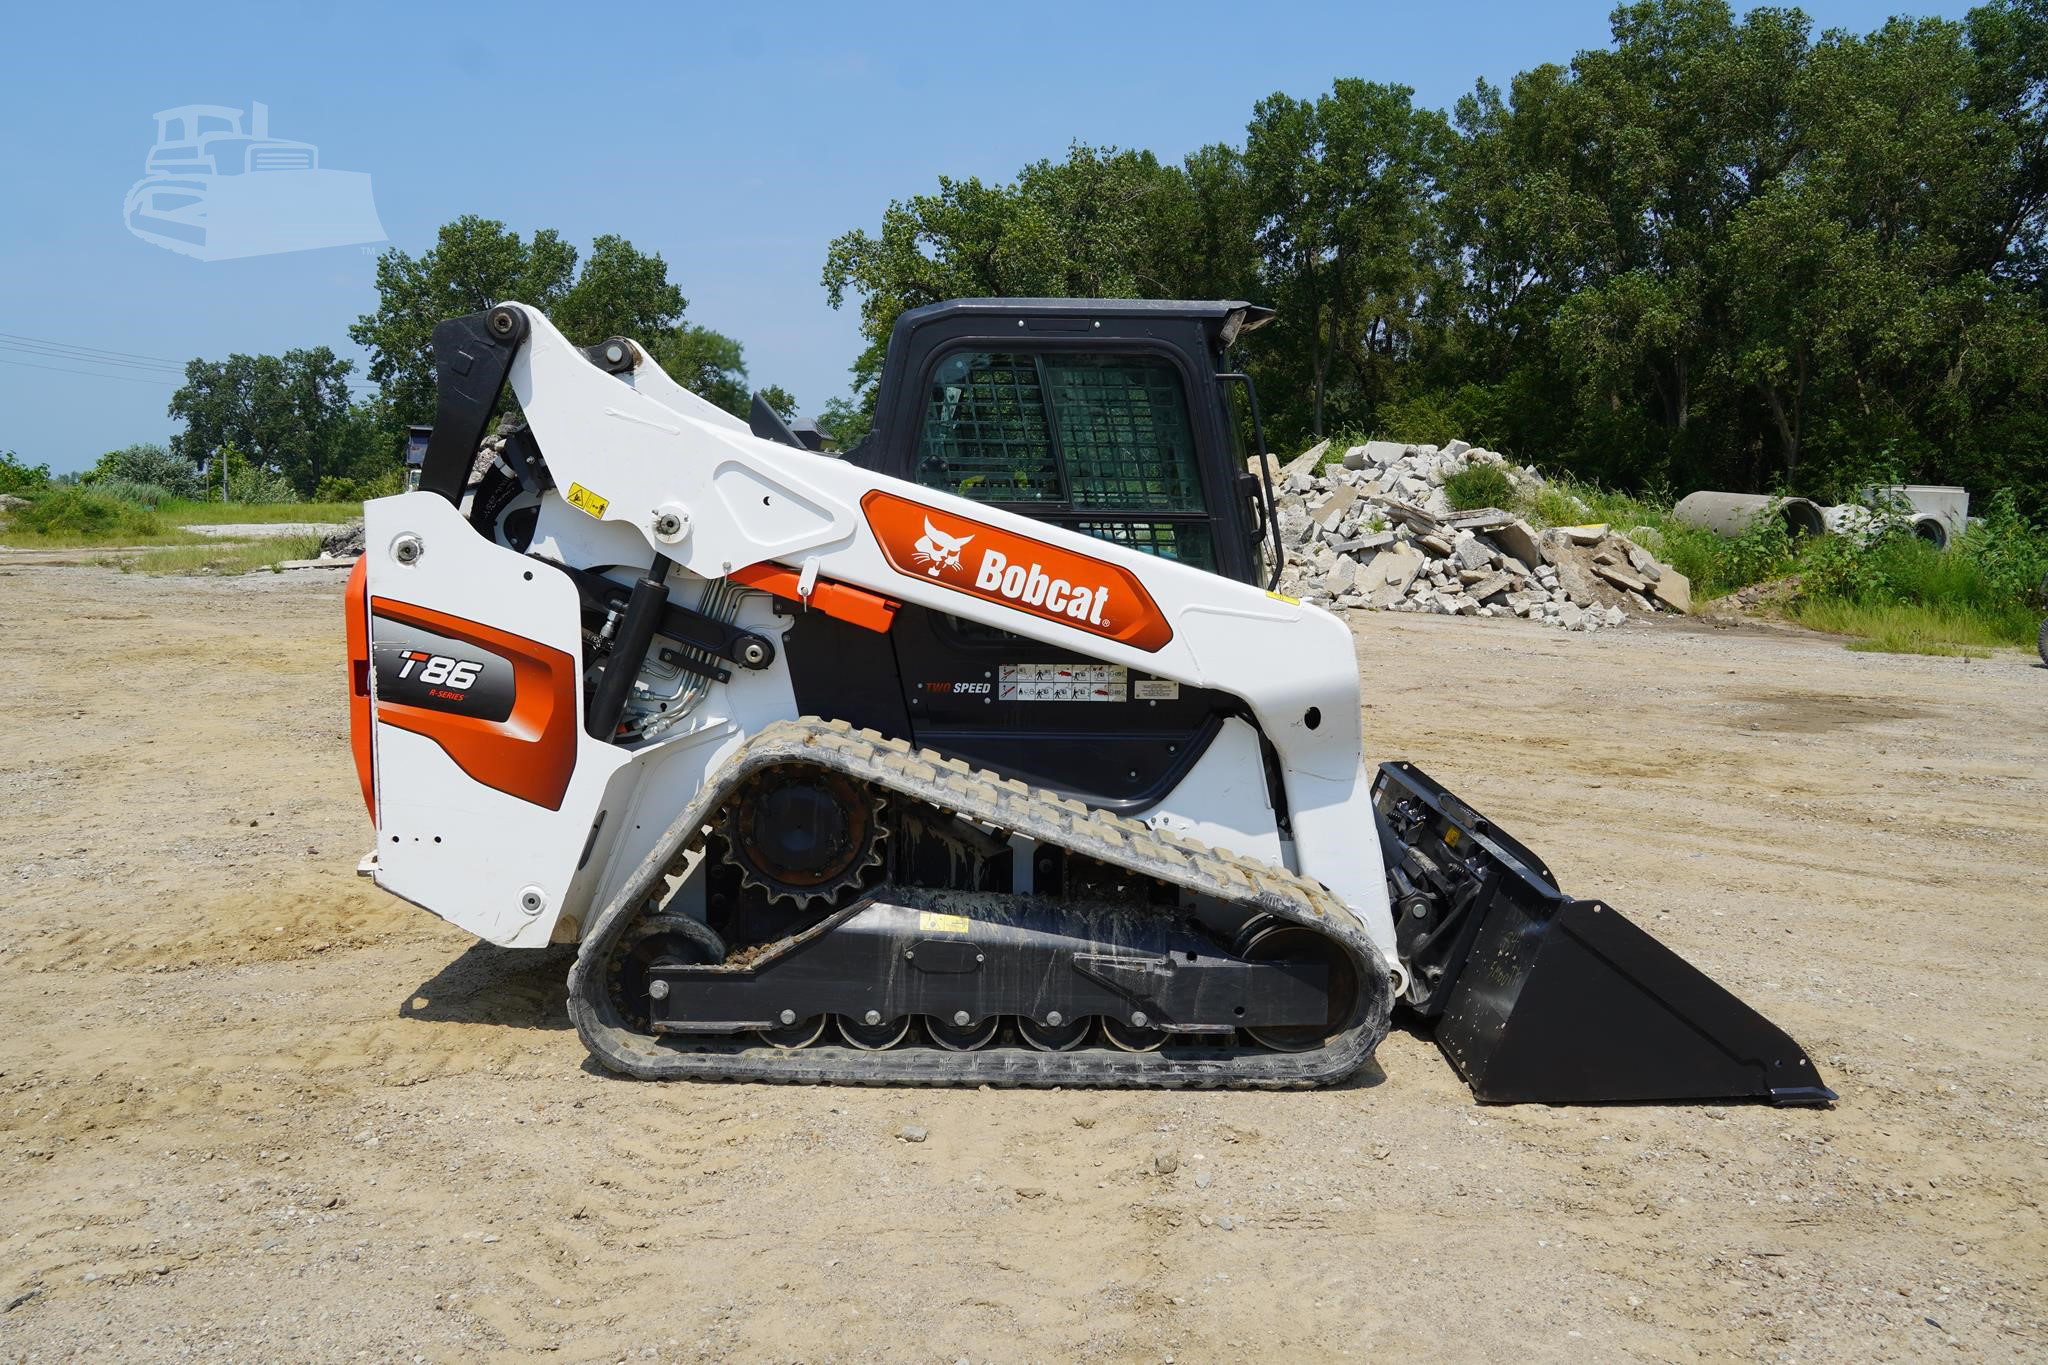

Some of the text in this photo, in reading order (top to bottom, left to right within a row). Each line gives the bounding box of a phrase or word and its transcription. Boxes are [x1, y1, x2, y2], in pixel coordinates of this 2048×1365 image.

[975, 548, 1109, 626] Bobcat
[398, 649, 483, 690] T86
[428, 688, 465, 702] R-SERIES
[926, 682, 991, 695] TWO SPEED
